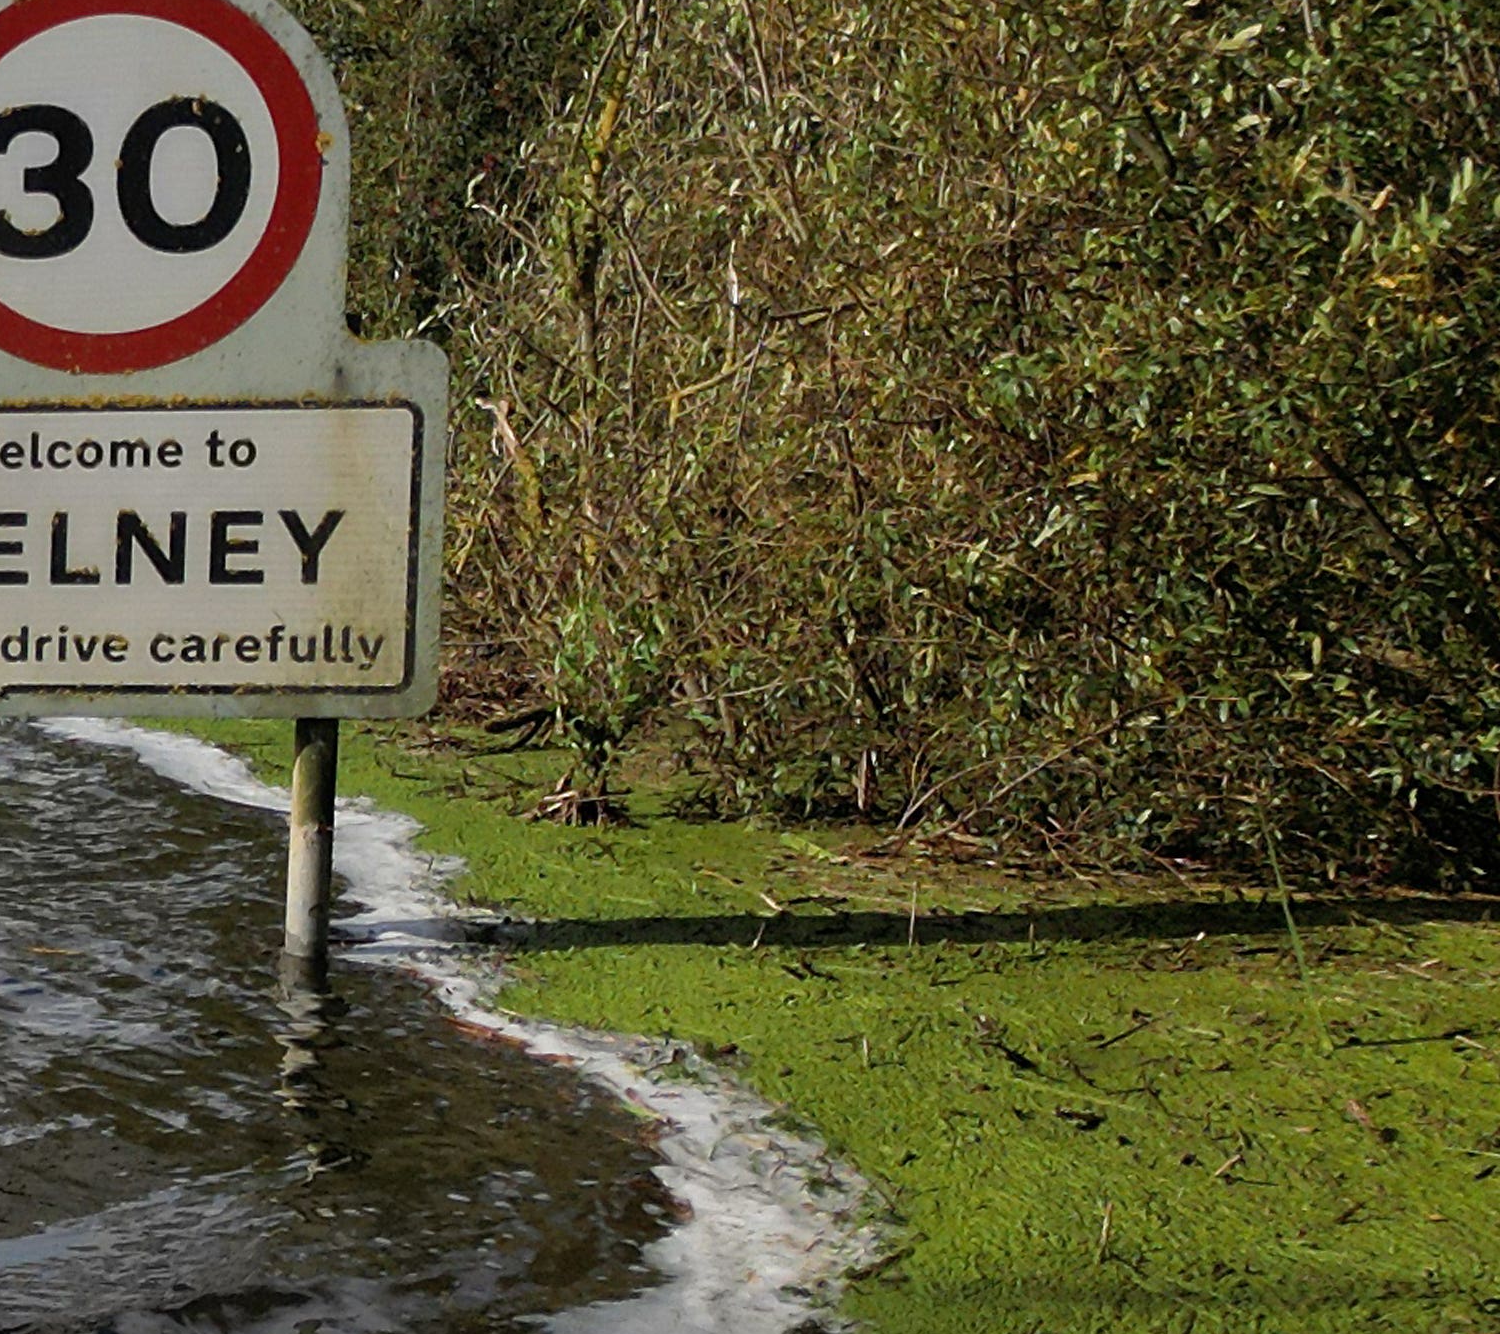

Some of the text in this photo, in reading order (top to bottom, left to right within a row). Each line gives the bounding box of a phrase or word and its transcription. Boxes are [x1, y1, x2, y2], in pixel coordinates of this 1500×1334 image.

[206, 431, 256, 469] to
[1, 625, 127, 662] drive
[150, 625, 384, 670] carefully
